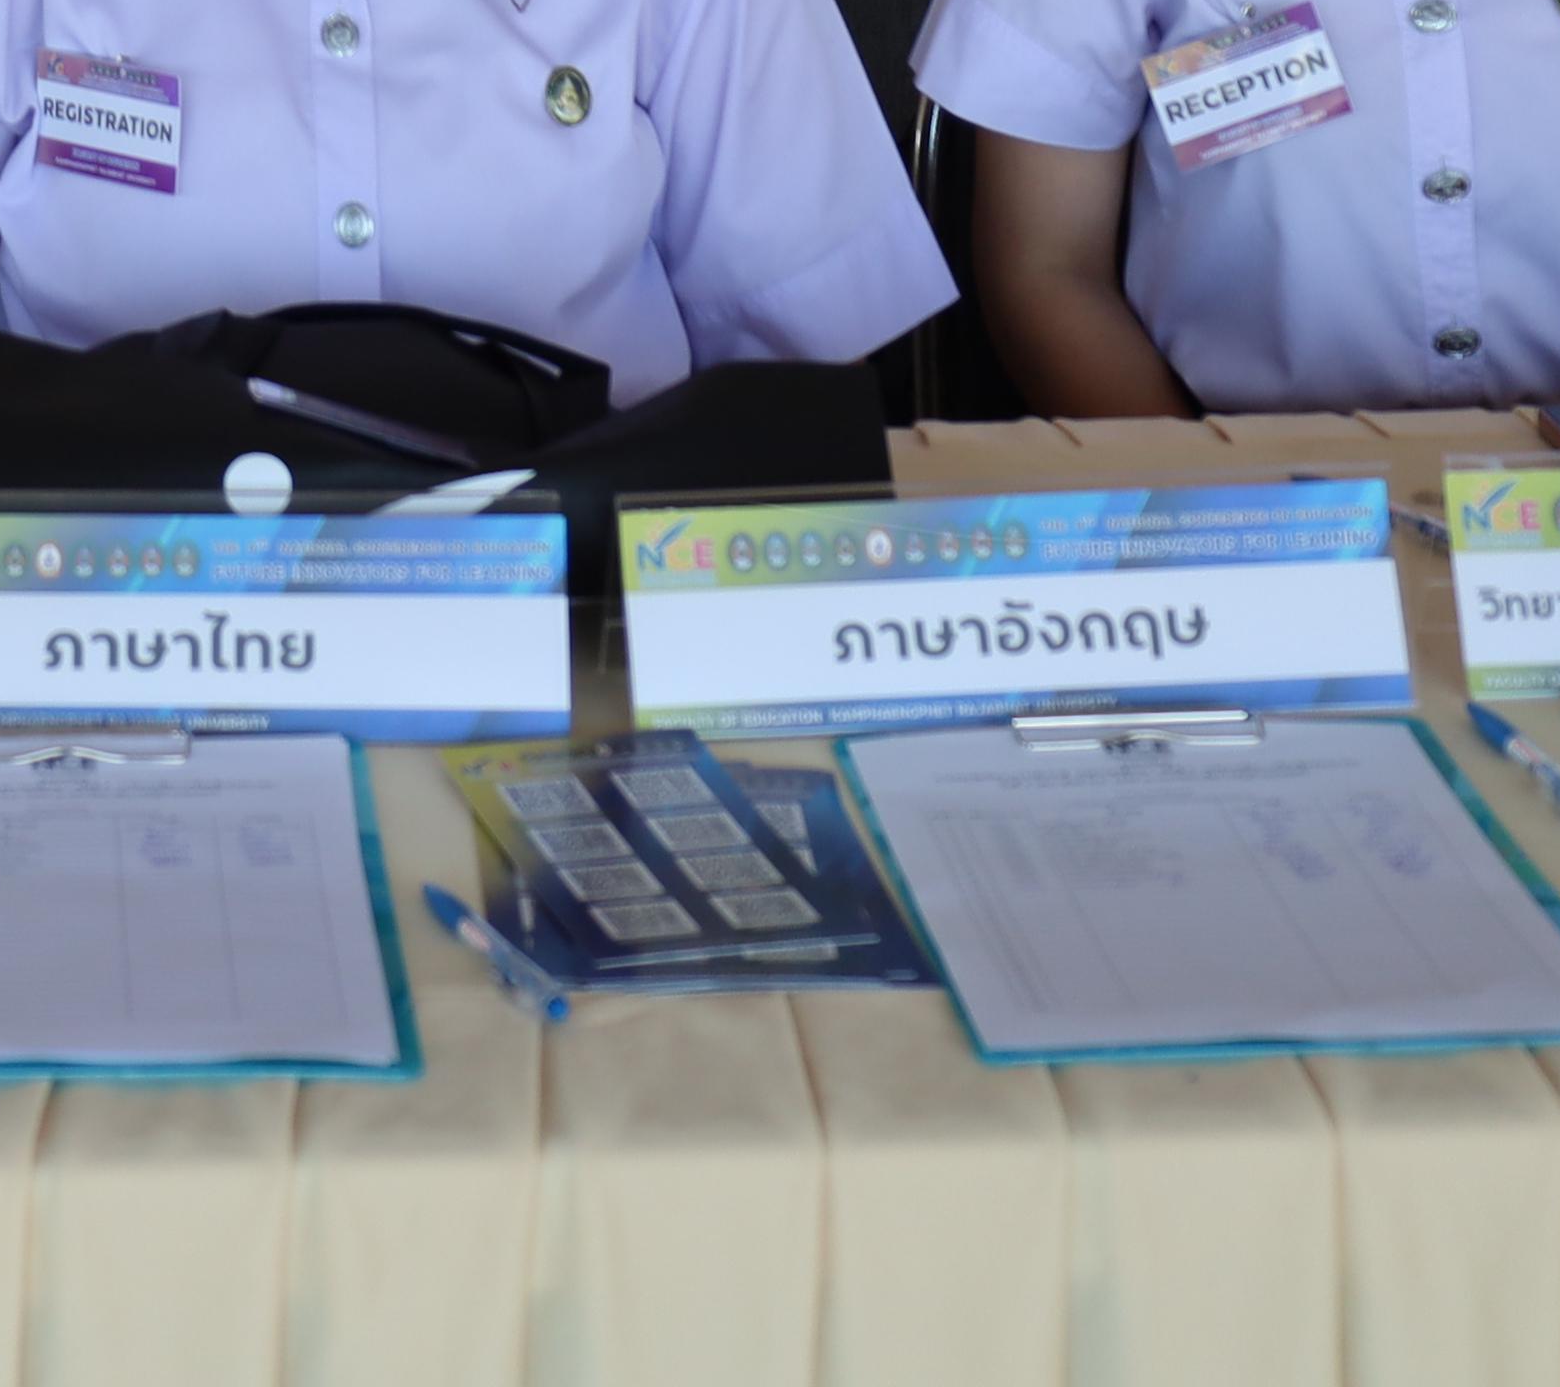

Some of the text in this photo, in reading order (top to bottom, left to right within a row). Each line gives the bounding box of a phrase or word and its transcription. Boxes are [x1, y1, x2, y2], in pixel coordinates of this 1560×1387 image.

[1164, 48, 1329, 125] RECEPTION
[43, 96, 173, 143] REGISTRATION
[44, 609, 315, 670] ภาษาไทย
[834, 599, 1210, 662] ภาษาอังกฤษ
